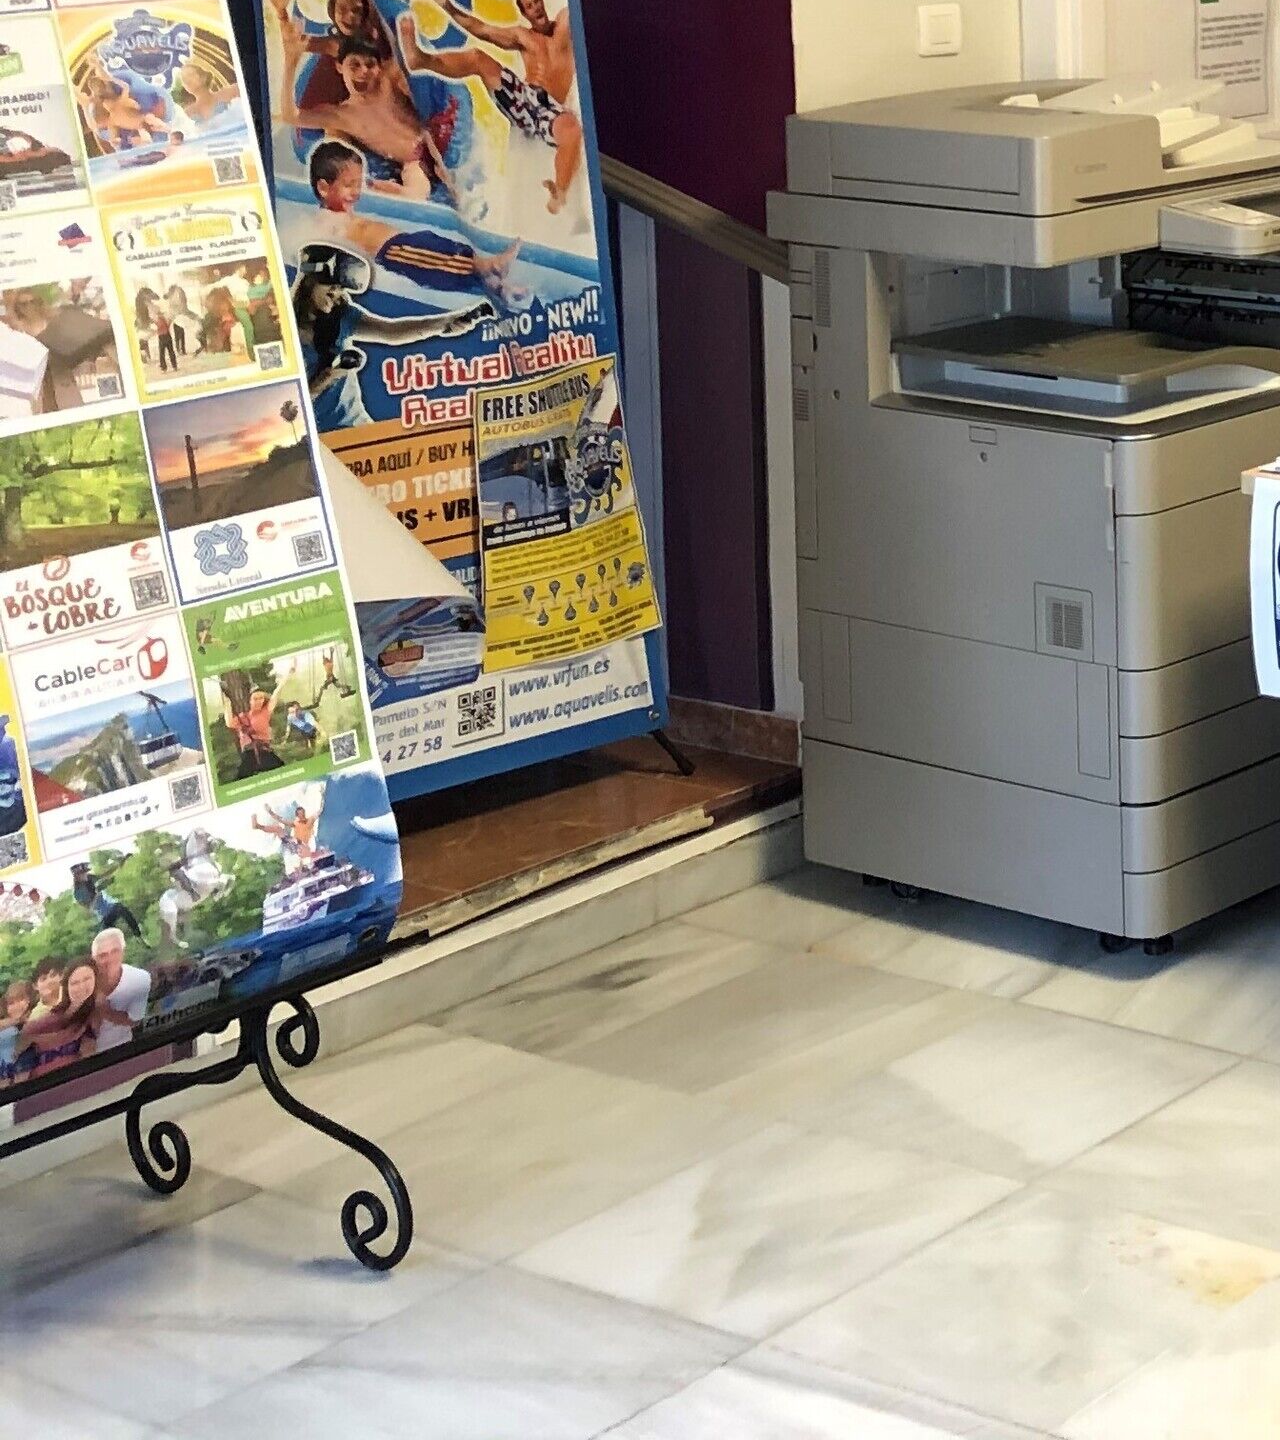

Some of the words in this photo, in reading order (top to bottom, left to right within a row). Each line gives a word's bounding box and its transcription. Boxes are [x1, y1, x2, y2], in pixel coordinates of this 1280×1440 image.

[547, 289, 600, 330] NEW!!
[382, 343, 512, 395] Virtual
[482, 394, 524, 423] FREE
[482, 418, 545, 436] AUTOBUS
[428, 442, 458, 464] BUY
[4, 577, 102, 620] BOSQUE
[43, 597, 121, 635] COBRE
[224, 582, 333, 624] AVENTURA
[34, 654, 134, 692] CableCar
[509, 659, 611, 697] www.vrfun.es
[509, 680, 650, 729] www.aquavelis.com
[397, 741, 418, 762] 27
[423, 735, 443, 754] 58
